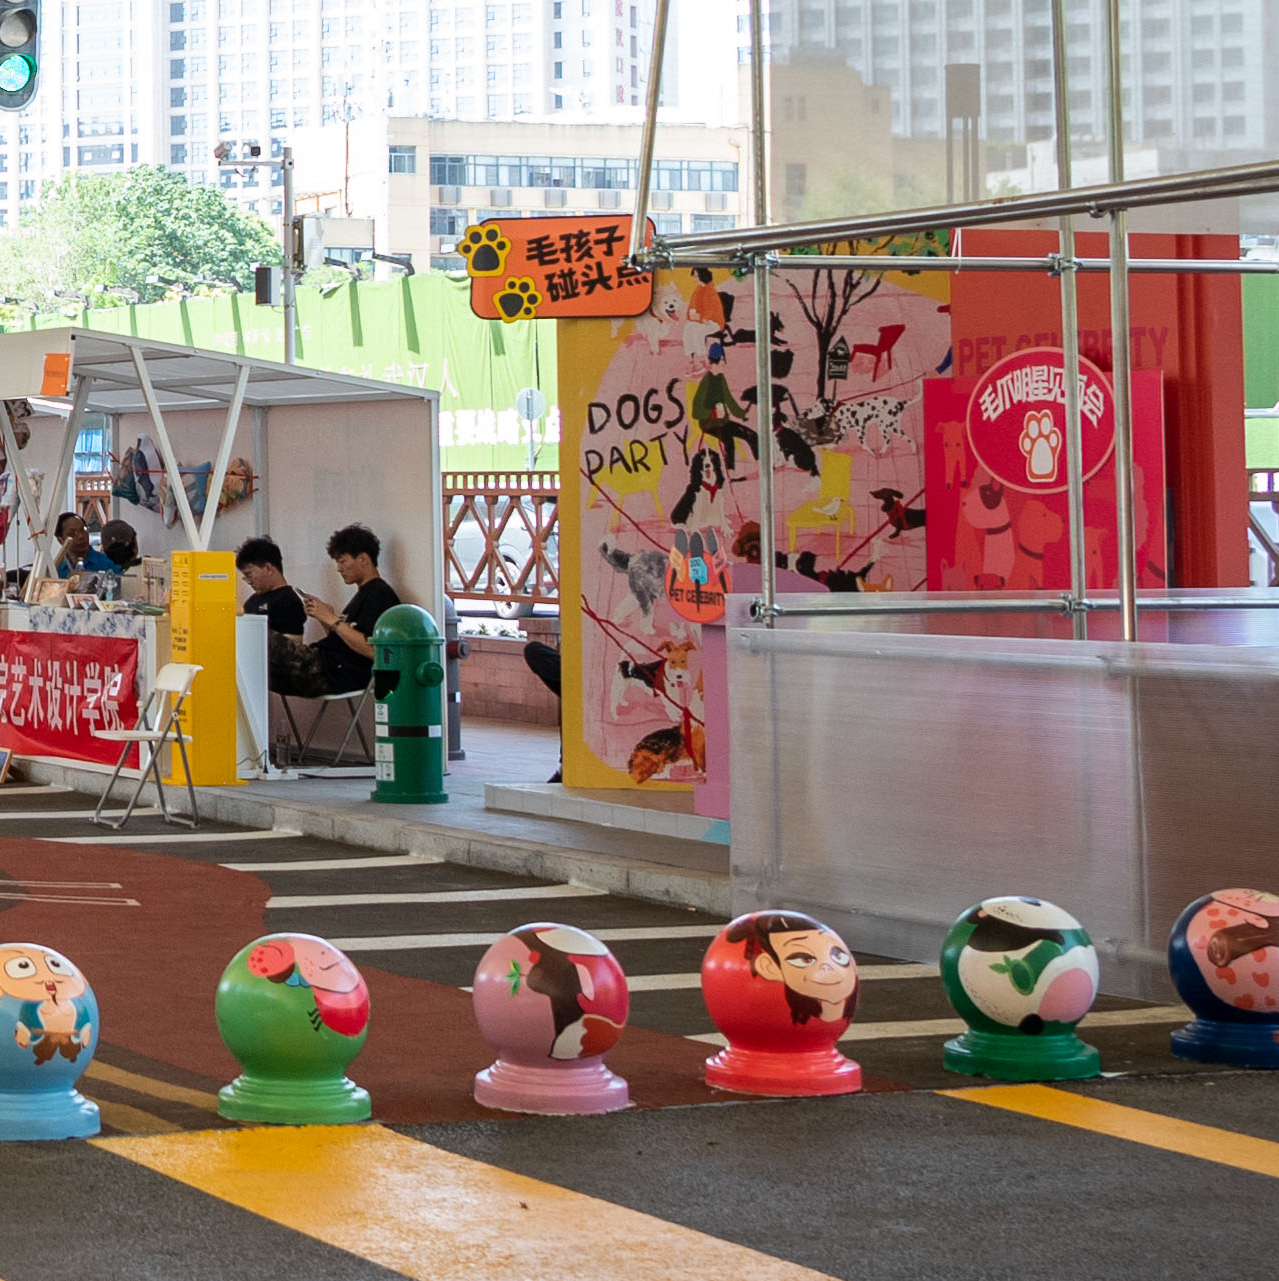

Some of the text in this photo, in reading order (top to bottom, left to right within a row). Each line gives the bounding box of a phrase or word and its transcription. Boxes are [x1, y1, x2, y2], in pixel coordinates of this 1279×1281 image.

[525, 224, 625, 267] 毛孩子
[544, 260, 650, 303] 碰头点
[588, 377, 684, 434] DOGS
[585, 424, 689, 485] PARTY
